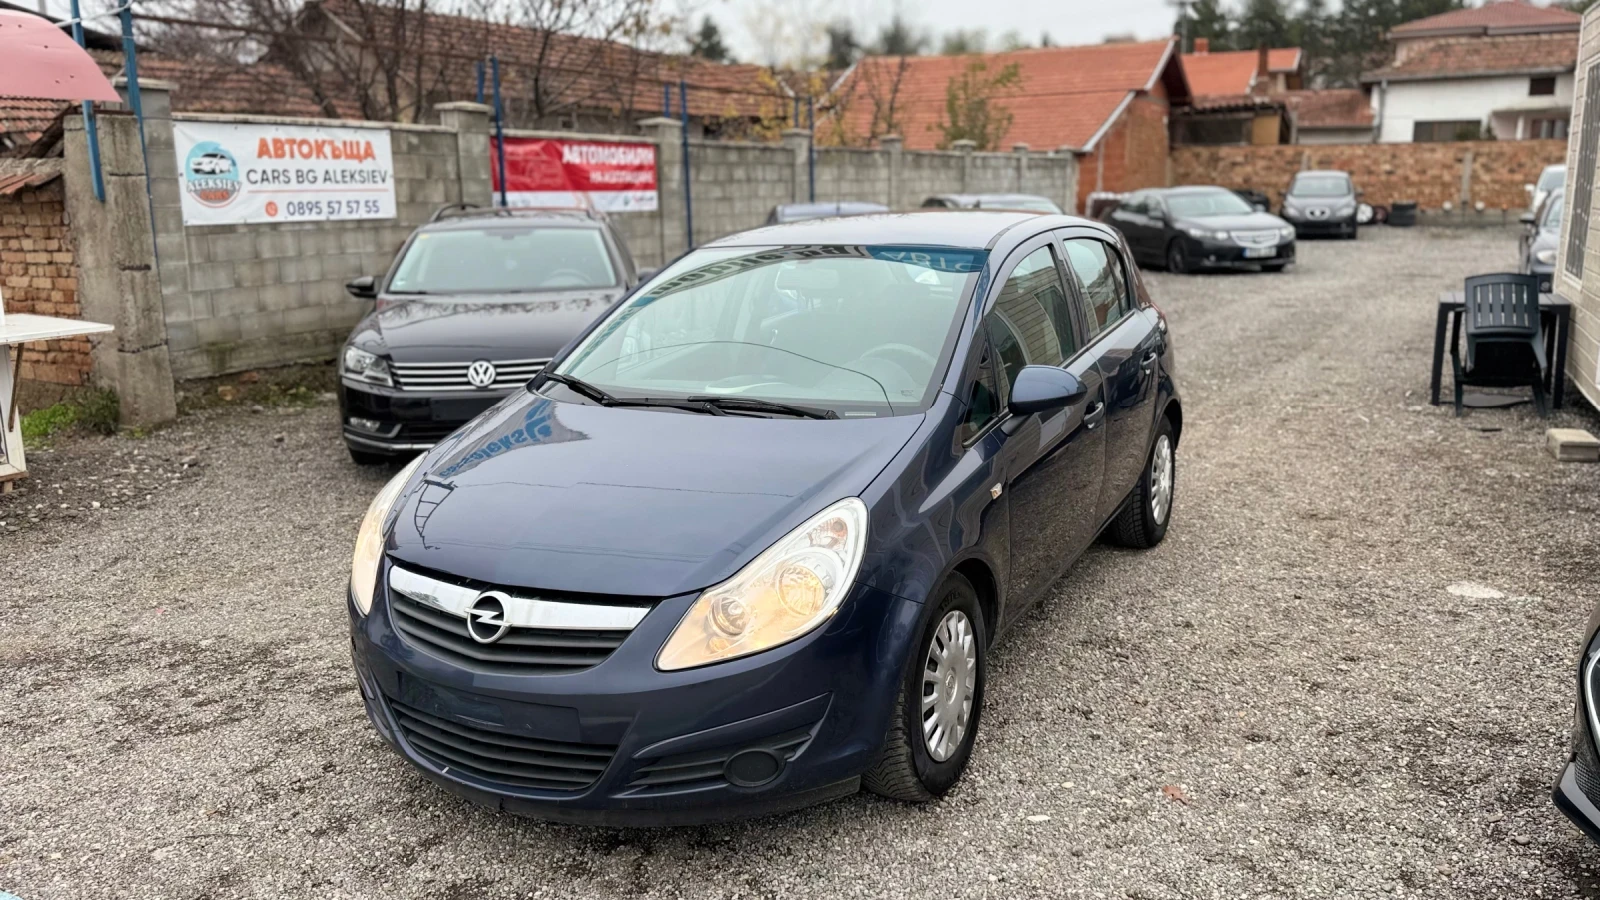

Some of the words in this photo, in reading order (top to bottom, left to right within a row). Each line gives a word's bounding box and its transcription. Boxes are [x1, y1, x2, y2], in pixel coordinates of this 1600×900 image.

[257, 137, 376, 163] АВТОКЪЩА
[562, 144, 655, 166] АВТОМОБИЛИ
[246, 168, 291, 185] CARS
[296, 169, 318, 184] BG
[322, 169, 388, 184] ALEKSIEV
[186, 178, 243, 193] ALEKSIEV
[286, 201, 323, 216] 0895
[327, 201, 342, 215] 57
[346, 200, 361, 214] 57
[364, 200, 380, 214] 55
